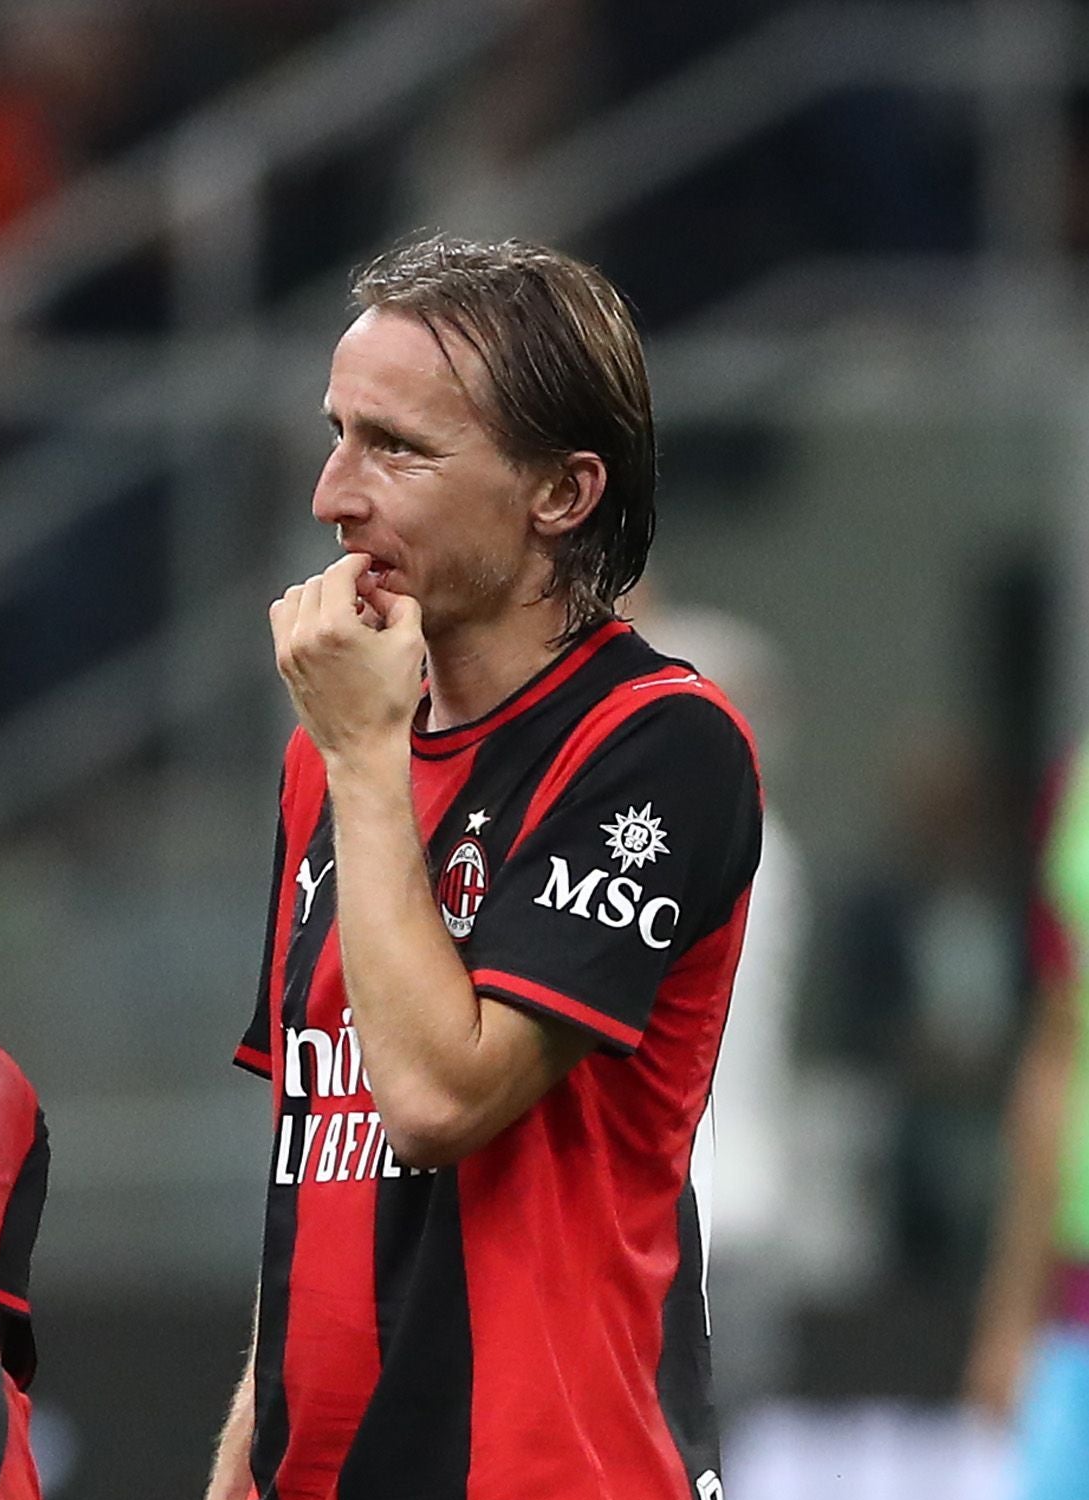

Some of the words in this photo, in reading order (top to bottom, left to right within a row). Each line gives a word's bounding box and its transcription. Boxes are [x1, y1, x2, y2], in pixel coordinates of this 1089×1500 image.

[448, 917, 472, 931] 1899
[534, 856, 680, 949] MSC
[315, 1112, 439, 1183] BETT
